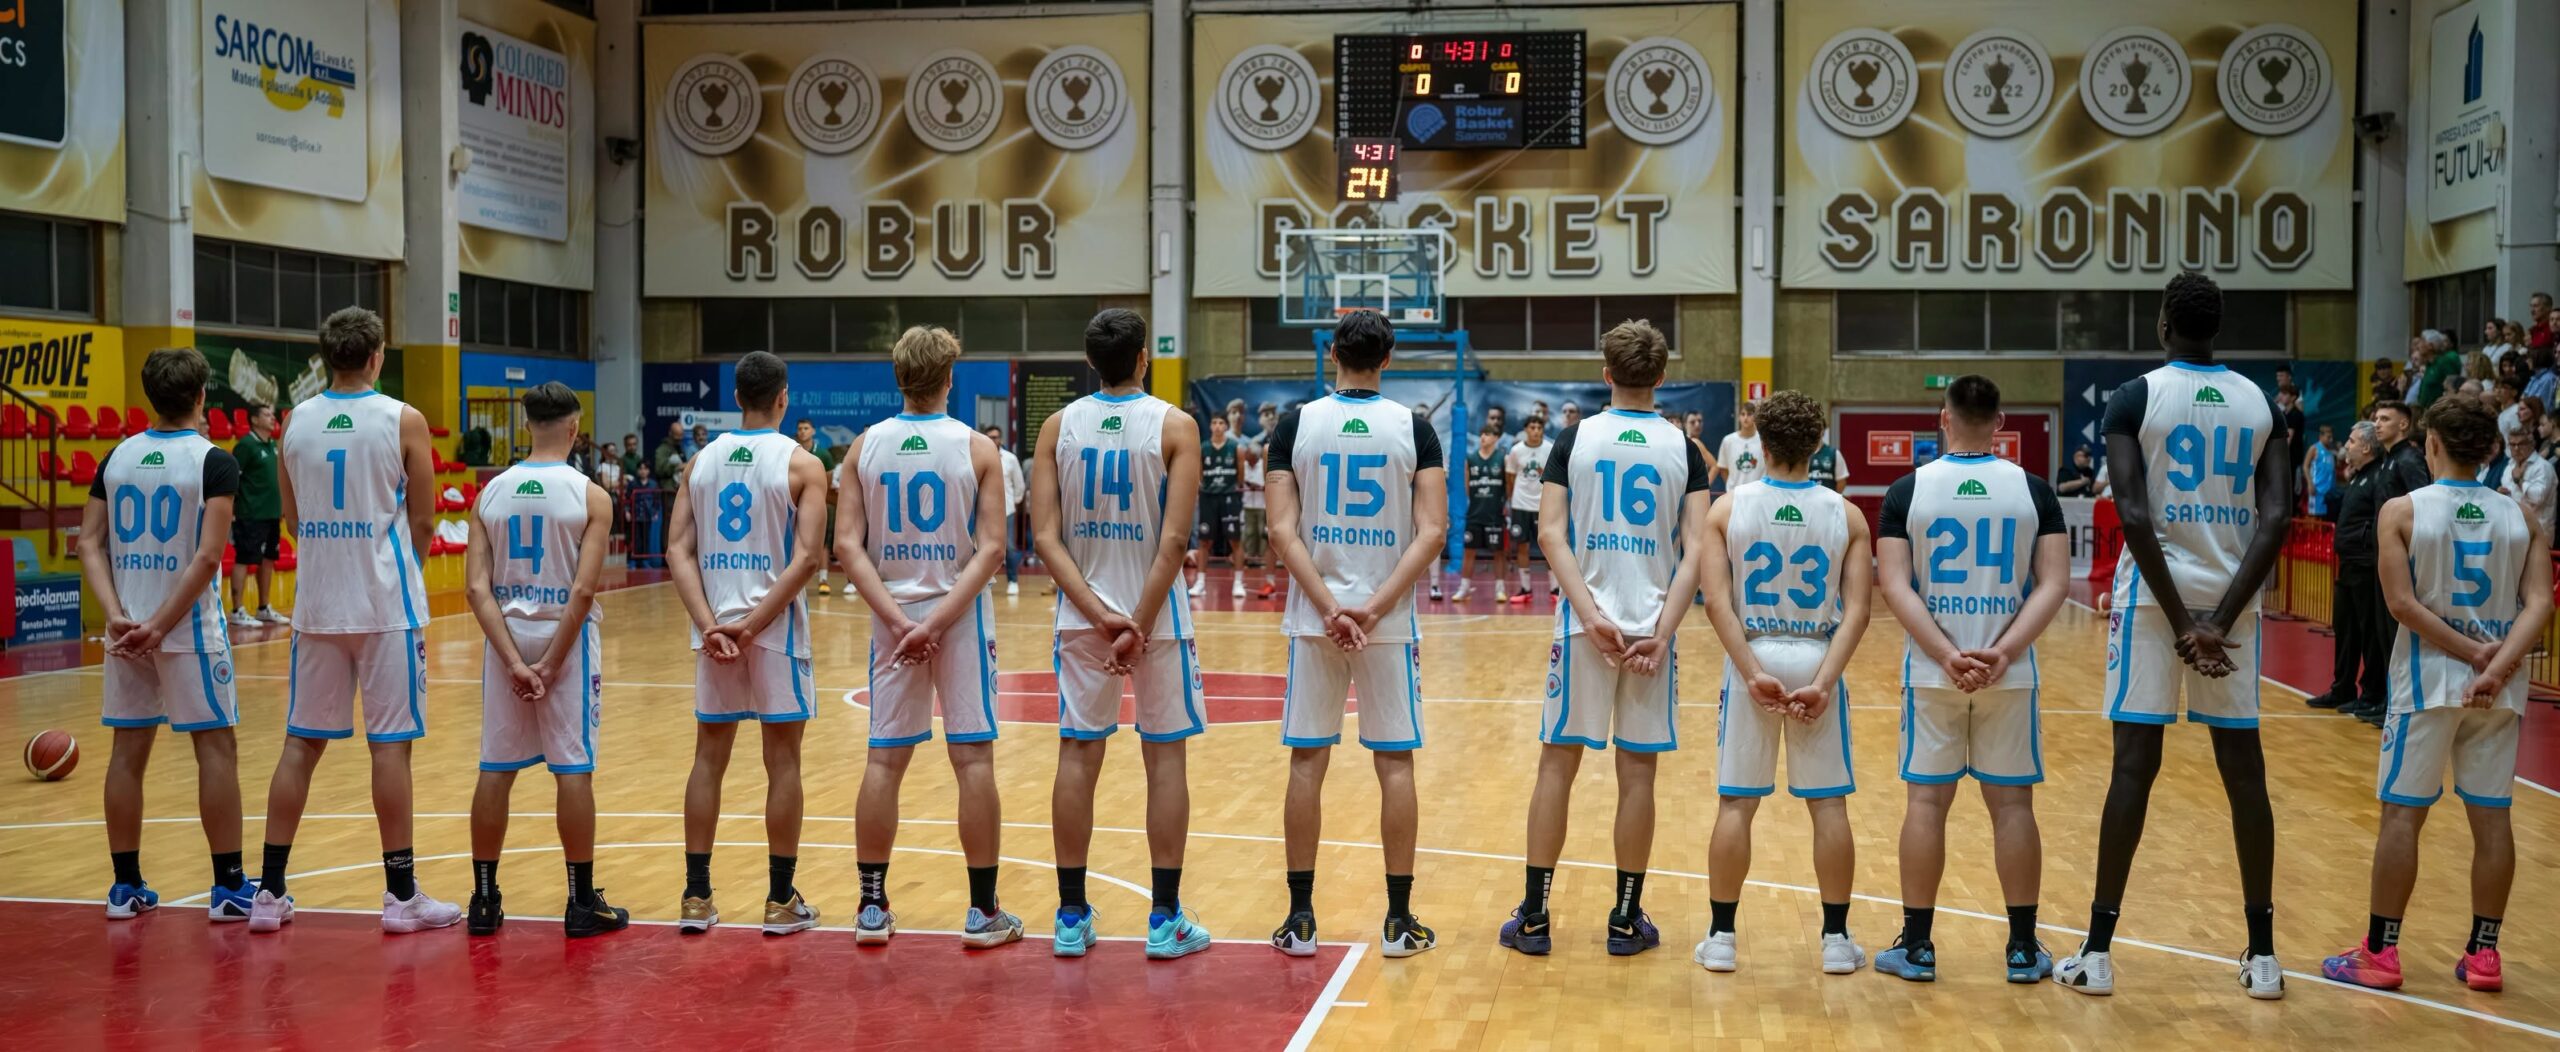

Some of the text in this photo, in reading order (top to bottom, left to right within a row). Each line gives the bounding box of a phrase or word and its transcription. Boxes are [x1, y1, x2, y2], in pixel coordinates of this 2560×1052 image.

[215, 14, 314, 76] SARCOM
[1411, 45, 1422, 59] 0
[1444, 41, 1488, 61] 4:31
[1501, 43, 1512, 57] 0
[496, 42, 565, 89] COLORED
[1399, 63, 1431, 73] OSPITI
[1491, 61, 1518, 71] CASA
[232, 68, 263, 89] Materie
[266, 79, 304, 99] plastiche
[1416, 73, 1431, 94] 0
[1505, 72, 1520, 93] 0
[496, 71, 565, 129] MINDS
[1455, 105, 1505, 117] Robur
[1455, 117, 1514, 129] Basket
[1455, 130, 1507, 141] Saronno
[1355, 144, 1394, 160] 4:31
[1347, 167, 1389, 198] 24
[726, 199, 1056, 279] ROBUR
[1256, 195, 1669, 278] BASKET
[1820, 186, 2315, 271] SARONNO
[662, 382, 692, 393] USCITA
[863, 391, 901, 407] WORLD
[2165, 423, 2256, 495] 94
[326, 448, 347, 511] 1
[1081, 447, 1133, 512] 14
[1320, 452, 1388, 518] 15
[1594, 459, 1662, 527] 16
[114, 483, 182, 545] 00
[717, 481, 753, 543] 8
[880, 471, 946, 534] 10
[508, 514, 545, 576] 4
[1312, 525, 1396, 547] SARONNO
[1488, 534, 1499, 544] 12
[1586, 533, 1660, 557] SARONN
[882, 543, 955, 561] ARONNO
[1926, 516, 2016, 585] 24
[1744, 541, 1830, 610] 23
[2451, 540, 2493, 608] 5
[15, 587, 79, 608] mediolanum
[1927, 595, 2017, 616] SARONNO
[22, 620, 43, 631] Renato
